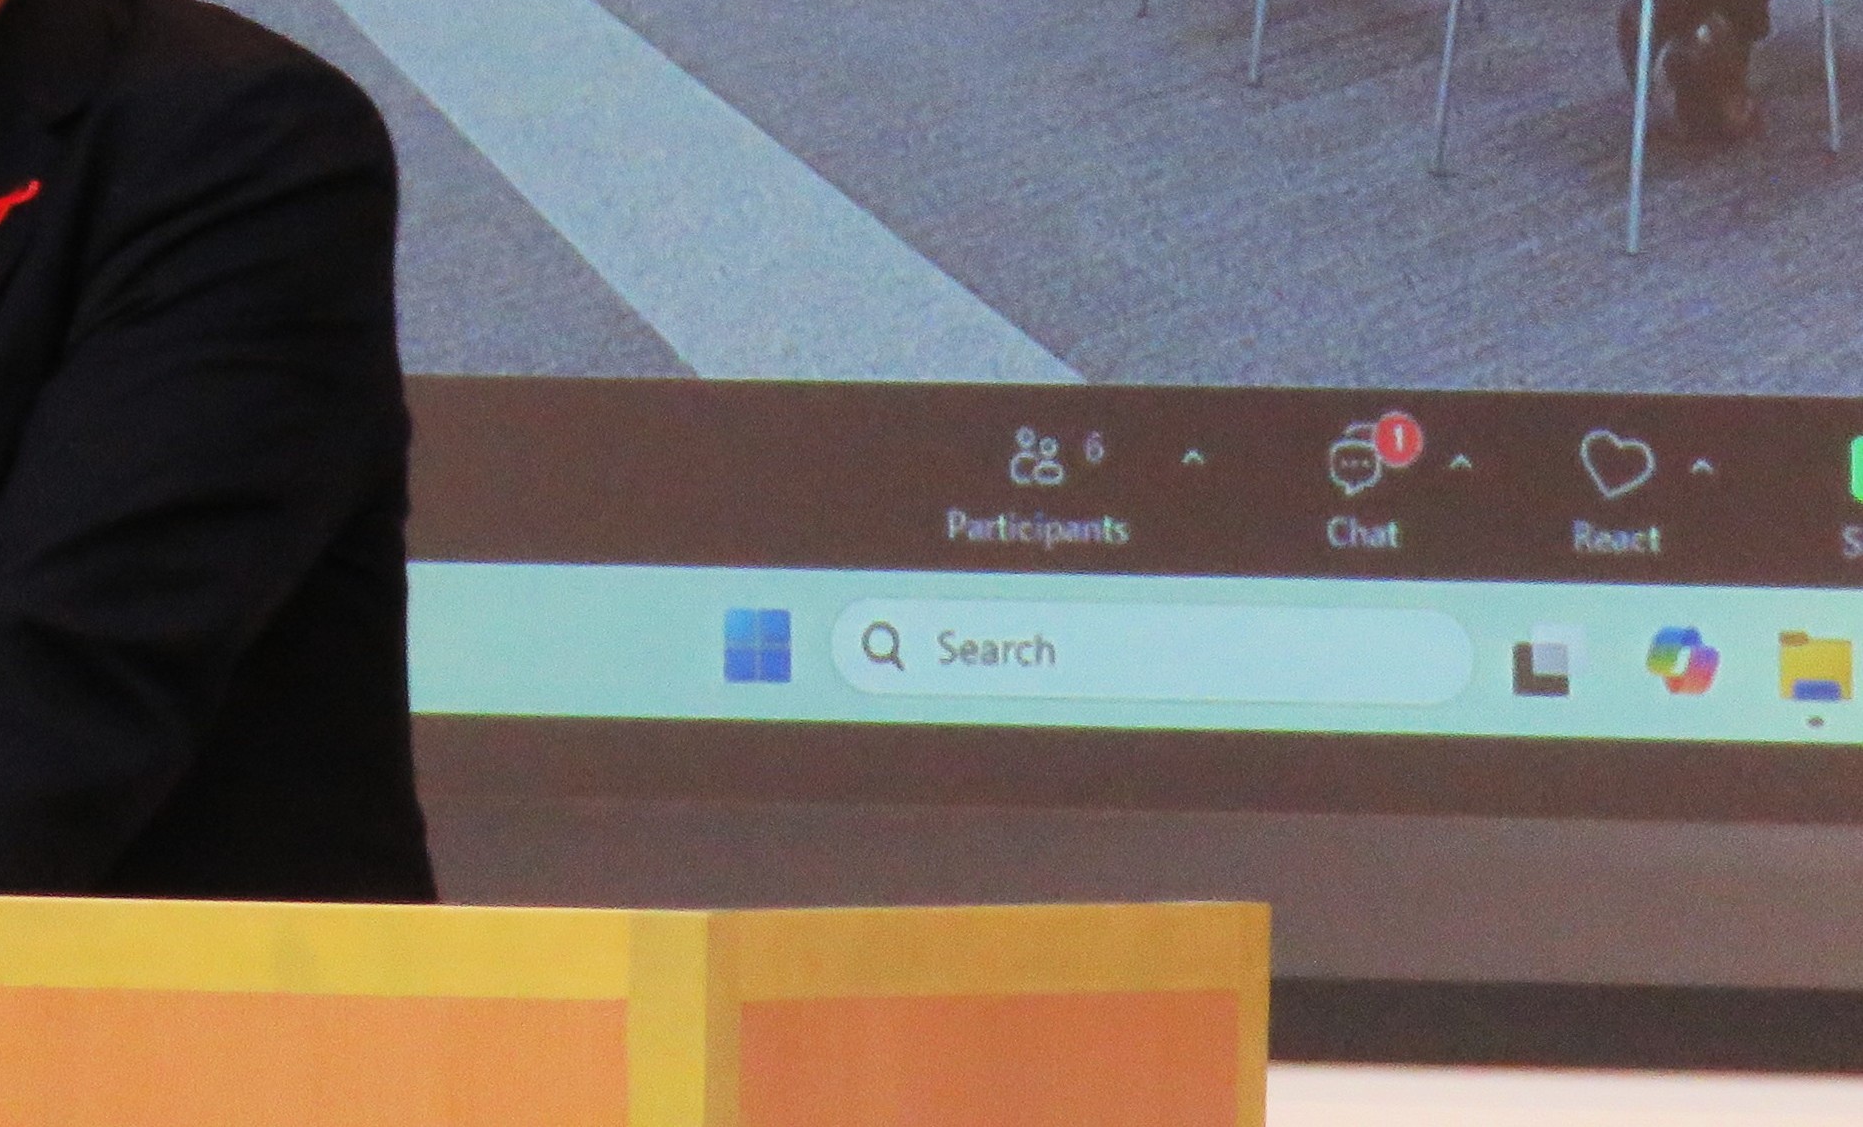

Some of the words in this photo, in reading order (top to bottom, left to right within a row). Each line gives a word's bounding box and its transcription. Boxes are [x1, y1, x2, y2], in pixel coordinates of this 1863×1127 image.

[1392, 423, 1405, 453] 1
[945, 507, 1131, 550] Participants
[1327, 515, 1400, 549] Chat
[1572, 519, 1661, 554] React
[937, 629, 1057, 667] Search
